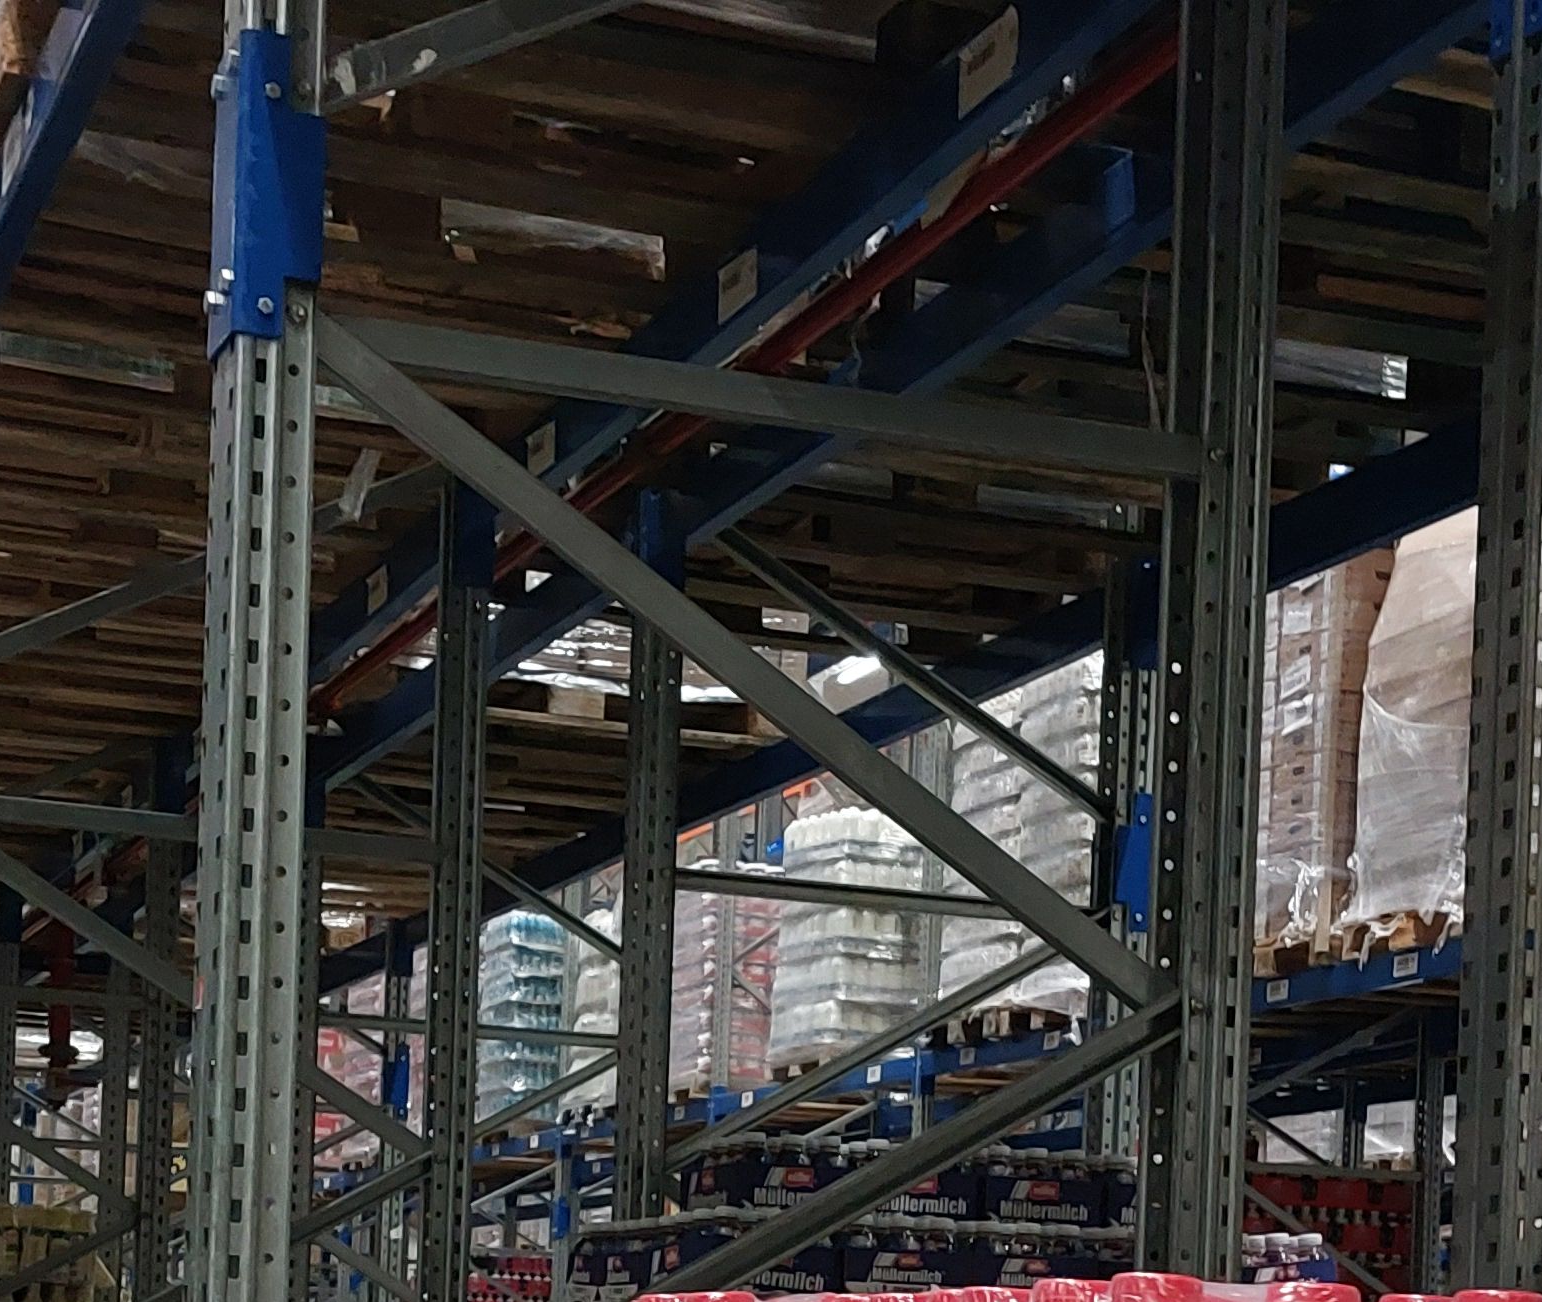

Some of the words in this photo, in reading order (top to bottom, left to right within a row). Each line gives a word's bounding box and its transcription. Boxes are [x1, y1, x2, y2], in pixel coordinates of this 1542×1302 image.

[753, 1186, 811, 1206] Müller
[999, 1199, 1089, 1222] Müllermilch
[749, 1270, 825, 1291] ermilch
